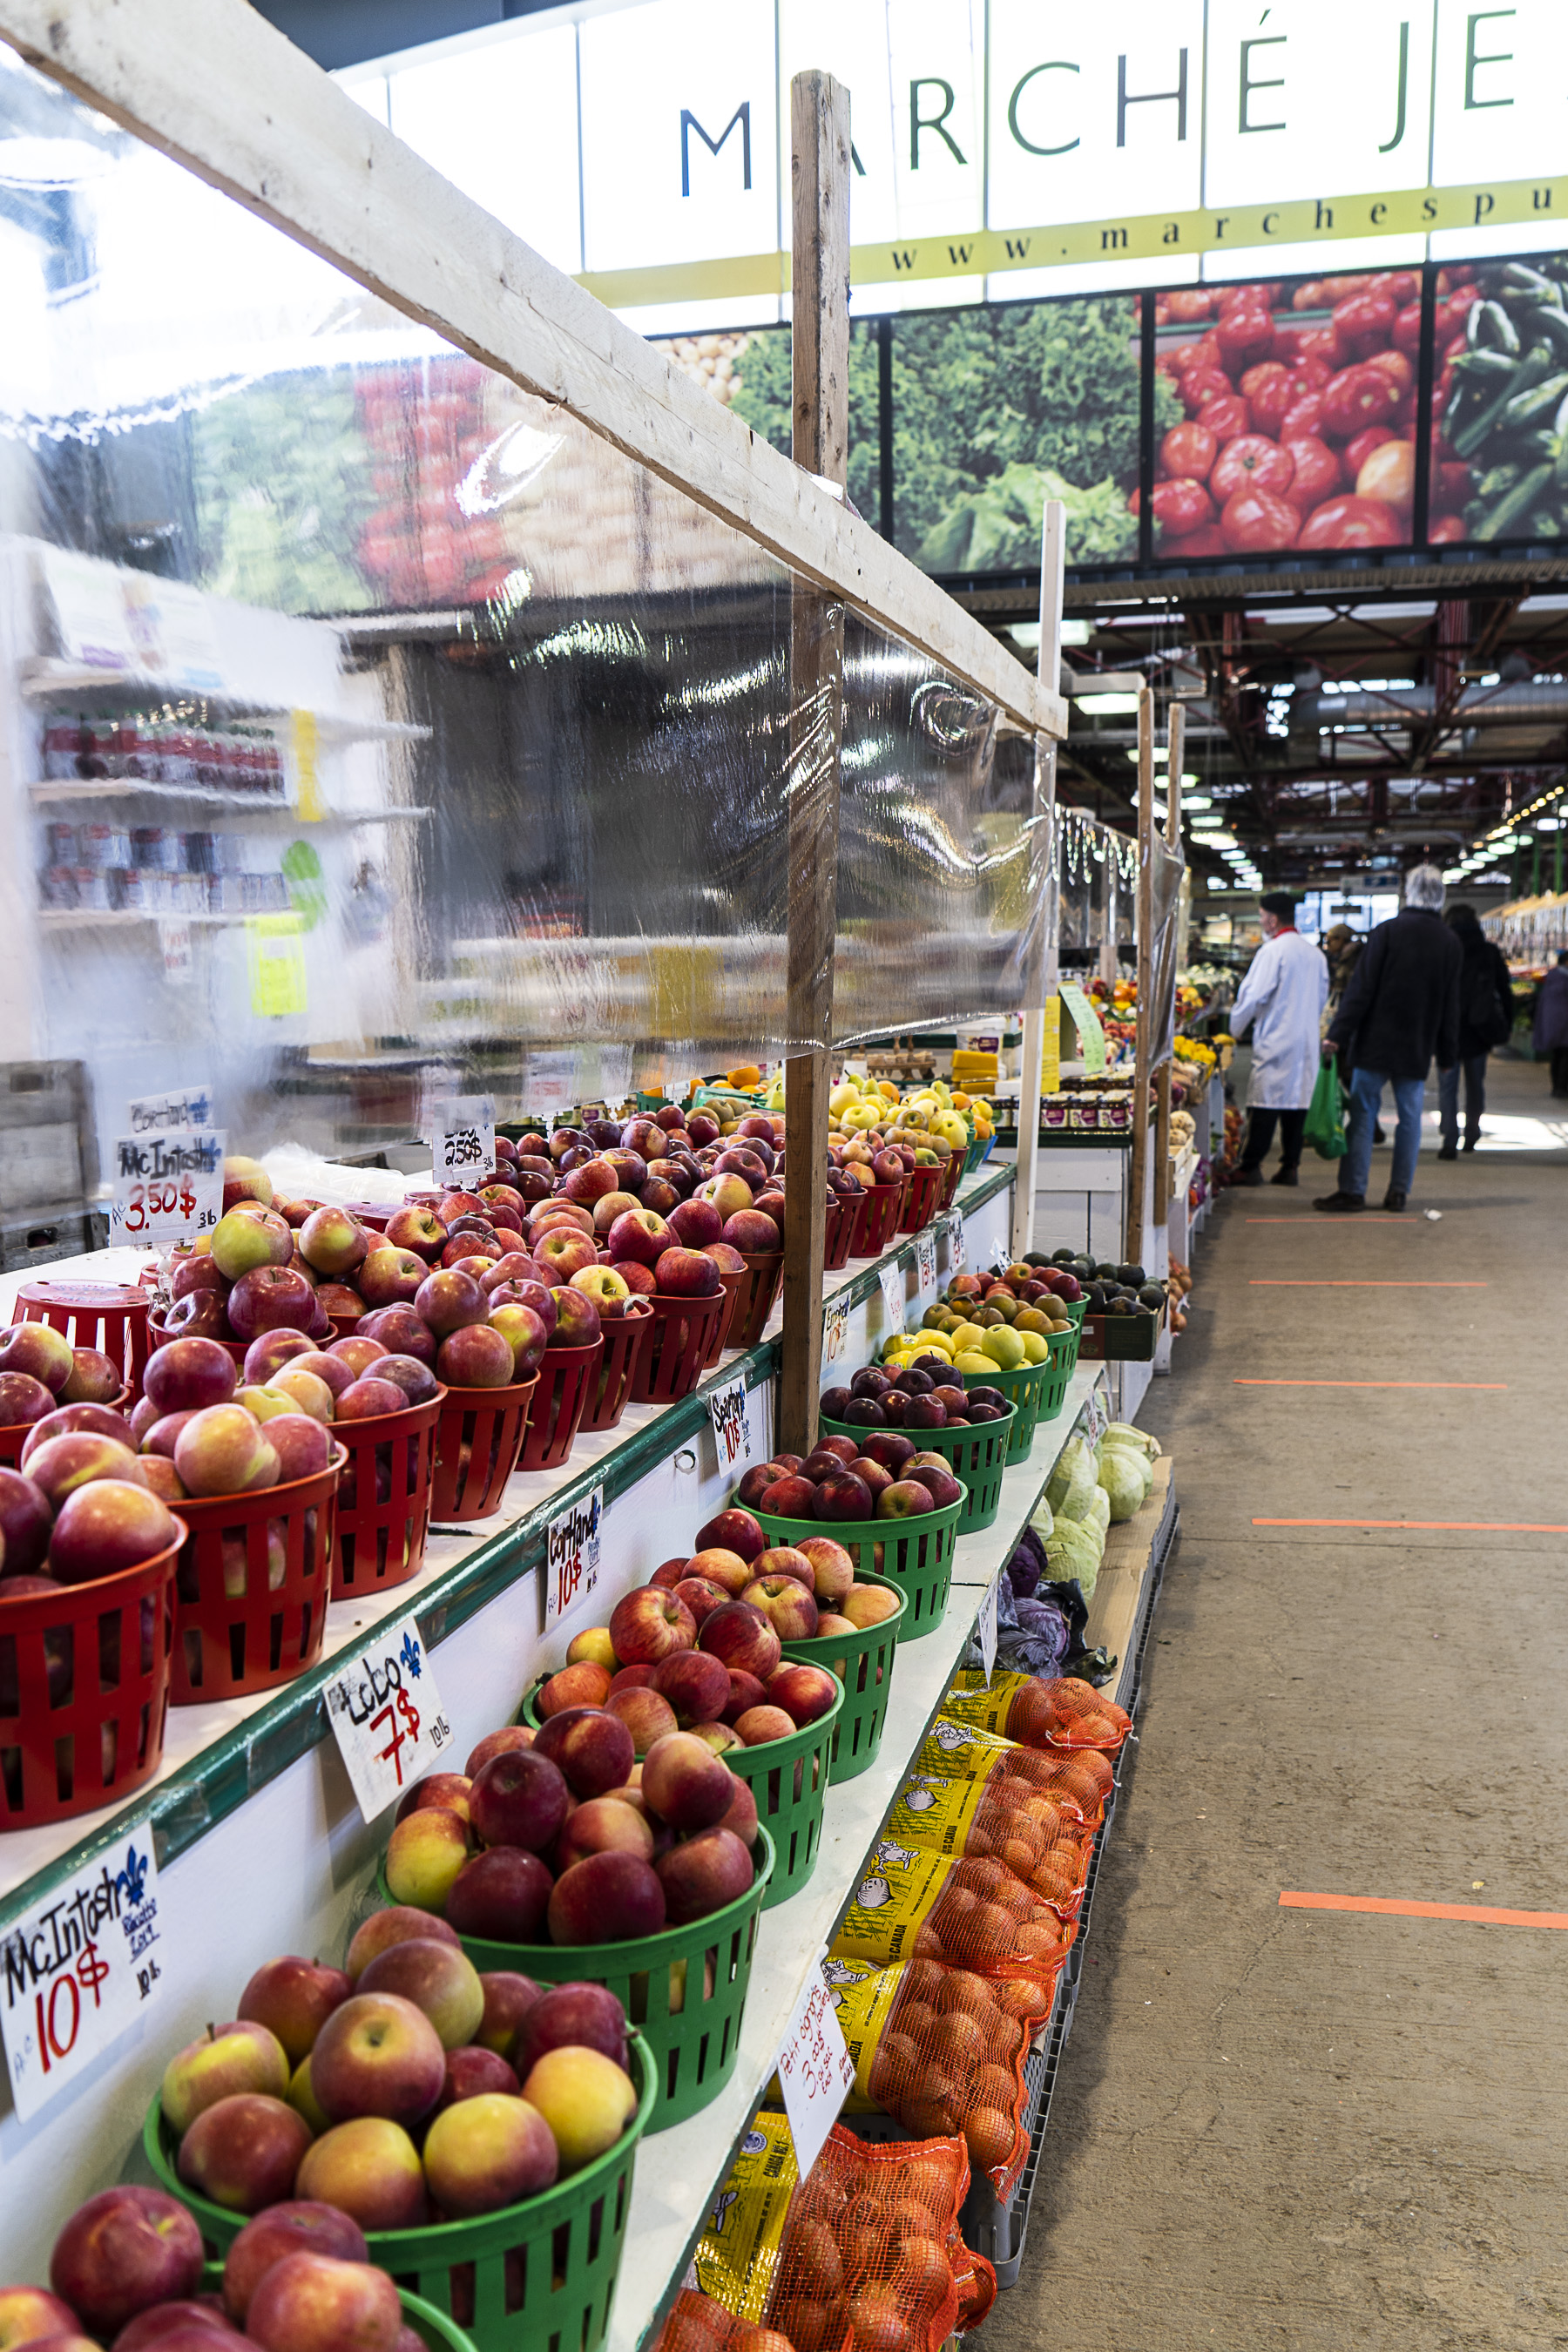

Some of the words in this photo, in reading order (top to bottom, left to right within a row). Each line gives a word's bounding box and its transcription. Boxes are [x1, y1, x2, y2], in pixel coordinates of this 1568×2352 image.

[680, 9, 1287, 197] MRCHÉ
[891, 188, 1551, 272] www.marchespu
[558, 1547, 582, 1616] 10$
[369, 1686, 420, 1786] 7$
[4, 1867, 121, 2009] McIntosh
[889, 1924, 908, 1954] CANADA
[36, 1939, 110, 2075] 10$
